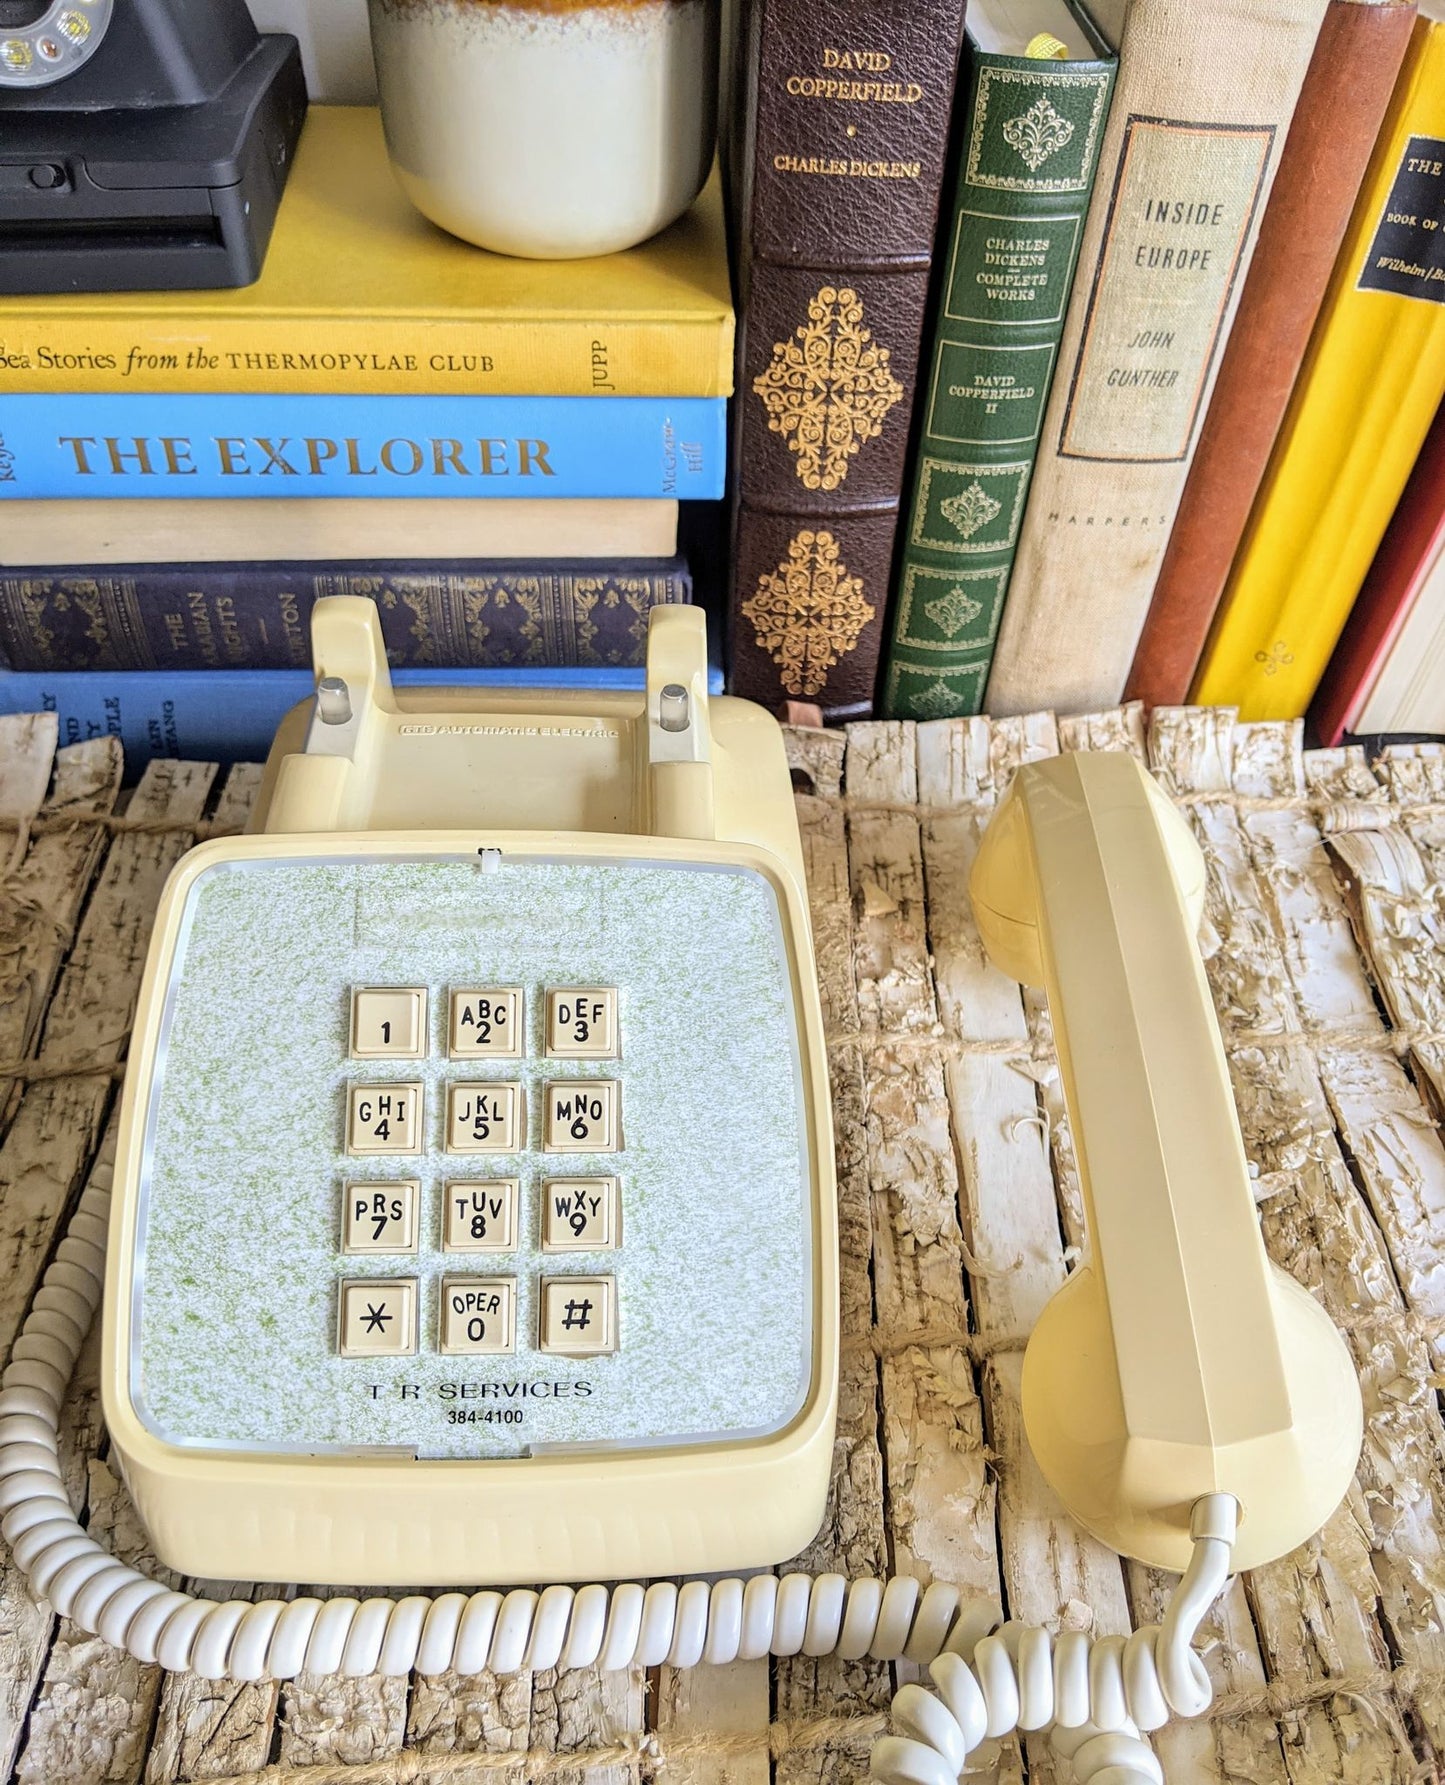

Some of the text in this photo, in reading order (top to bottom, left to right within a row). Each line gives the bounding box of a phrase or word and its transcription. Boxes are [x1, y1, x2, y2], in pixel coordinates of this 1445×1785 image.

[822, 48, 891, 72] DAVID
[786, 75, 923, 103] COPPERFIELD
[774, 154, 921, 178] CHARLES DICKENS
[1407, 158, 1443, 177] THE
[1144, 200, 1224, 226] INSIDE
[1386, 213, 1439, 231] BOOK OF
[986, 238, 1050, 252] CHARLES
[984, 252, 1046, 266] DICKENS
[1135, 246, 1212, 271] EUROPE
[976, 272, 1048, 287] COMPLETE
[986, 288, 1036, 301] WORKS
[1127, 331, 1176, 349] JOHN
[37, 346, 117, 370] Stories
[121, 345, 179, 376] from
[186, 346, 219, 369] the
[225, 353, 418, 371] THERMOPYLAE
[429, 354, 495, 372] CLUB
[591, 340, 615, 391] JUPP
[974, 375, 1016, 387] DAVID
[1107, 368, 1179, 388] GUNTHER
[949, 385, 1036, 400] COPPERFIELD
[984, 403, 998, 414] II
[58, 436, 558, 477] THE EXPLORER
[680, 441, 703, 473] Hill
[163, 613, 190, 650] THE
[438, 724, 538, 737] AUTOMATIC
[381, 1021, 391, 1045] 1
[475, 1021, 491, 1044] 2
[573, 1020, 589, 1043] 3
[373, 1117, 391, 1141] 4
[472, 1116, 490, 1141] 5
[570, 1115, 589, 1140] 6
[371, 1215, 388, 1241] 7
[469, 1214, 487, 1239] 8
[568, 1211, 587, 1237] 9
[452, 1292, 501, 1316] OPER
[365, 1380, 593, 1400] T R SERVICES
[447, 1409, 524, 1426] 384-4100
